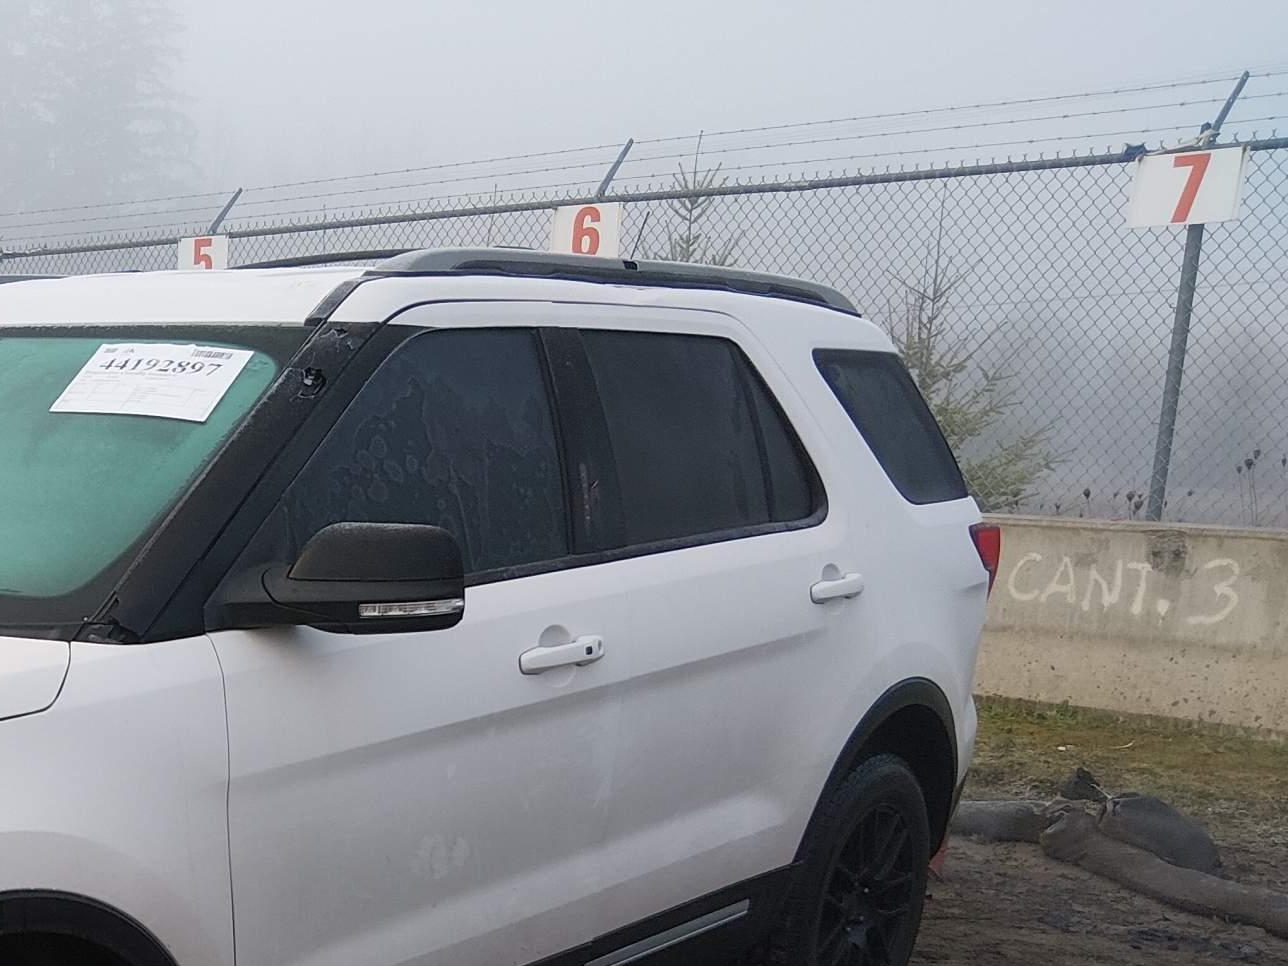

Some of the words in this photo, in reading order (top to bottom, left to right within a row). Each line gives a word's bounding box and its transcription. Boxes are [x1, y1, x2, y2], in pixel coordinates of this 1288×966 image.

[1170, 153, 1212, 224] 7
[193, 238, 213, 270] 5
[572, 206, 601, 256] 6
[99, 357, 224, 377] 44192897
[1008, 553, 1170, 616] CANT.
[1185, 558, 1240, 624] 3
